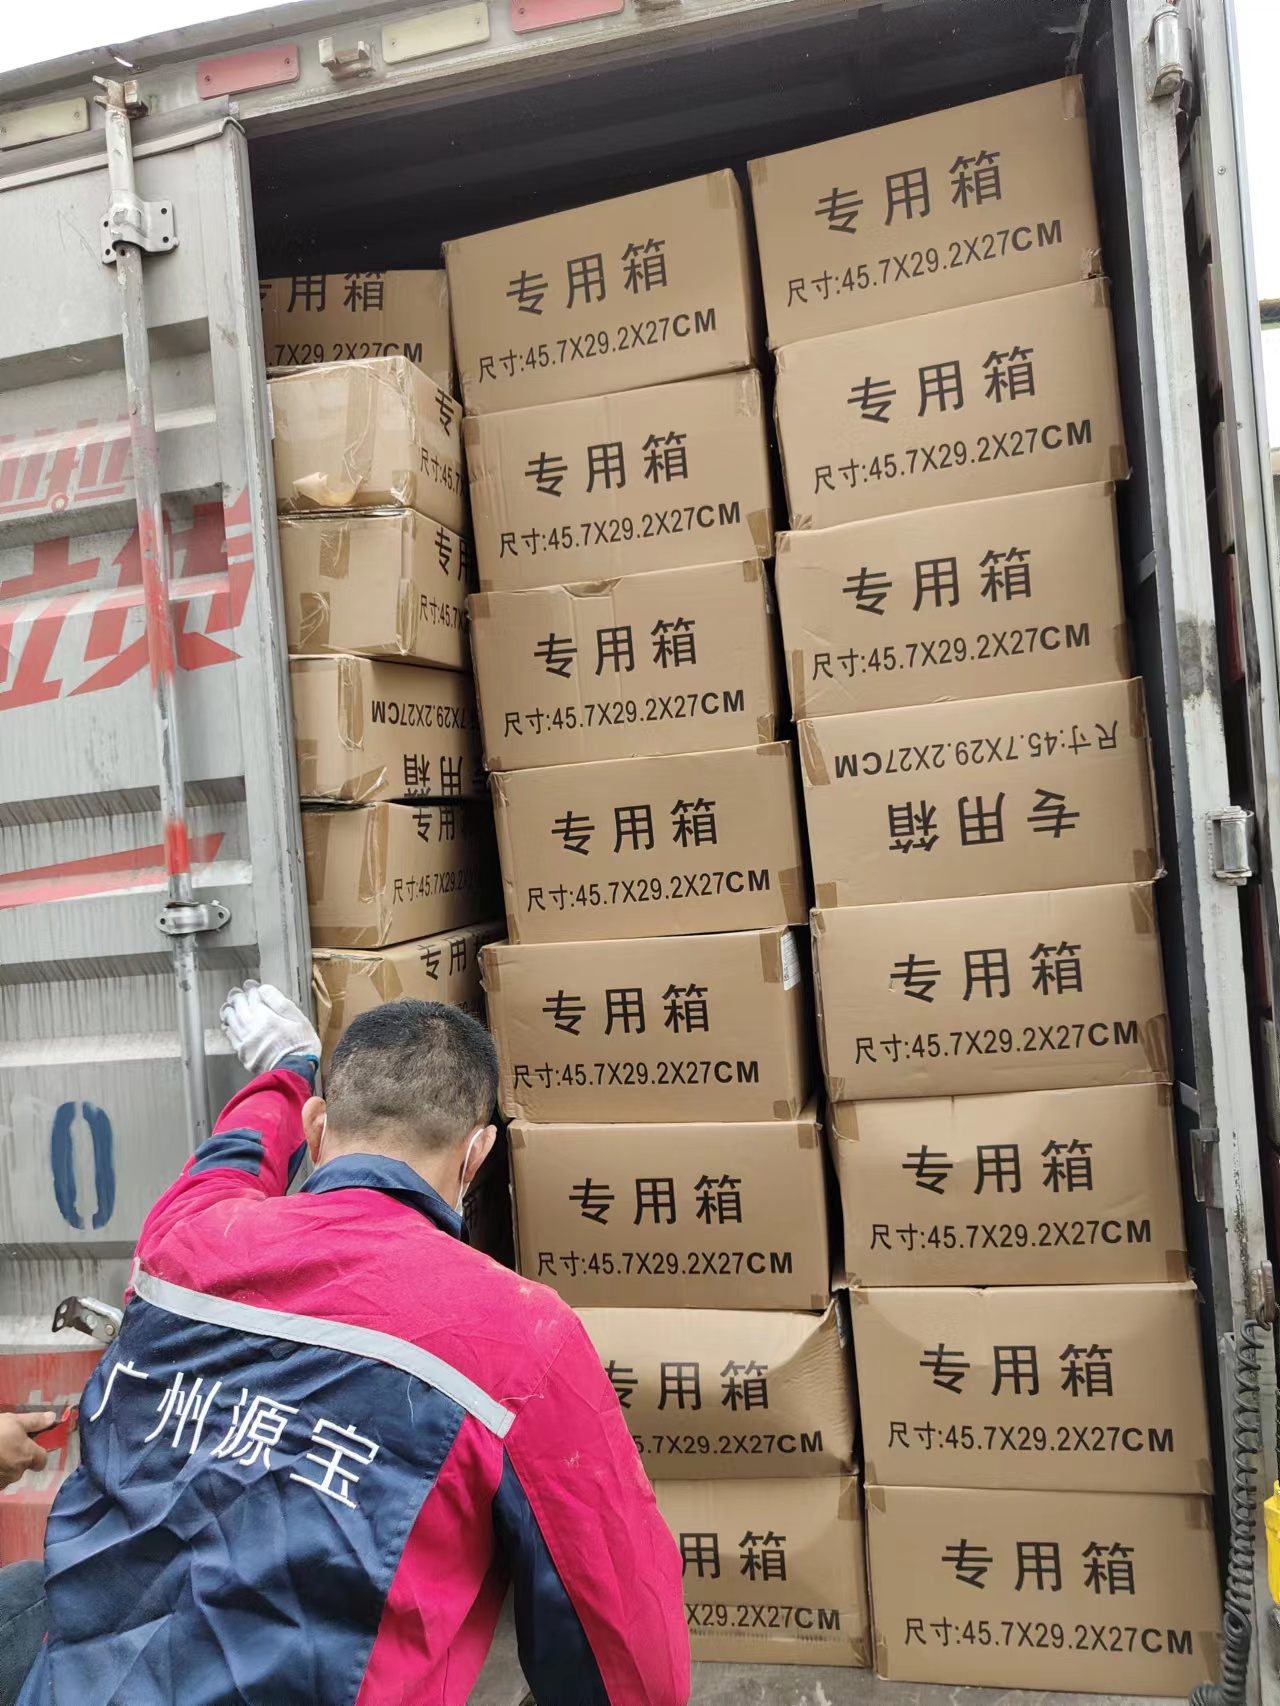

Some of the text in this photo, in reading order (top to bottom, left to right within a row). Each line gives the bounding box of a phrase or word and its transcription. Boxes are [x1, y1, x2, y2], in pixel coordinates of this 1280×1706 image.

[815, 149, 1002, 234] 专用箱
[506, 237, 668, 316] 专用箱
[787, 219, 1063, 307] 尺寸:45.7X29.2X27CM
[478, 307, 717, 383] 尺寸:45.7X29.2X27CM
[847, 345, 1036, 424] 专用箱
[525, 430, 689, 499] 专用箱
[814, 419, 1092, 494] 尺寸:45.7X29.2X27CM
[499, 501, 741, 559] 尺寸:45.7X29.2X27CM
[842, 546, 1032, 616] 专用箱
[534, 616, 698, 679] 专用箱
[812, 622, 1090, 681] 尺寸:45.7X29.2X27CM
[504, 689, 745, 738] 尺寸:45.7X29.2X27CM
[834, 719, 1118, 779] 尺寸:45.7X29.2X27CM
[551, 797, 718, 856] 专用箱
[888, 788, 1080, 854] 专用箱
[527, 869, 771, 912] 尺寸:45.7X29.2X27CM
[890, 940, 1083, 1004] 专用箱
[542, 983, 710, 1036] 专用箱
[855, 1020, 1138, 1064] 尺寸:45.7X29.2X27CM
[513, 1060, 759, 1089] 尺寸:45.7X29.2X27CM
[51, 1101, 116, 1230] 0
[902, 1138, 1093, 1195] 专用箱
[569, 1174, 742, 1226] 专用箱
[537, 1250, 793, 1277] 尺寸:45.7X29.2X27CM
[870, 1219, 1152, 1251] 尺寸:45.7X29.2X27CM
[919, 1342, 1114, 1397] 专用箱
[89, 1360, 380, 1509] 广州源宝
[888, 1420, 1175, 1453] 尺寸:45.7X29.2X27CM
[941, 1538, 1136, 1595] 专用箱
[904, 1616, 1194, 1655] 尺寸:45.7X29.2X27CM
